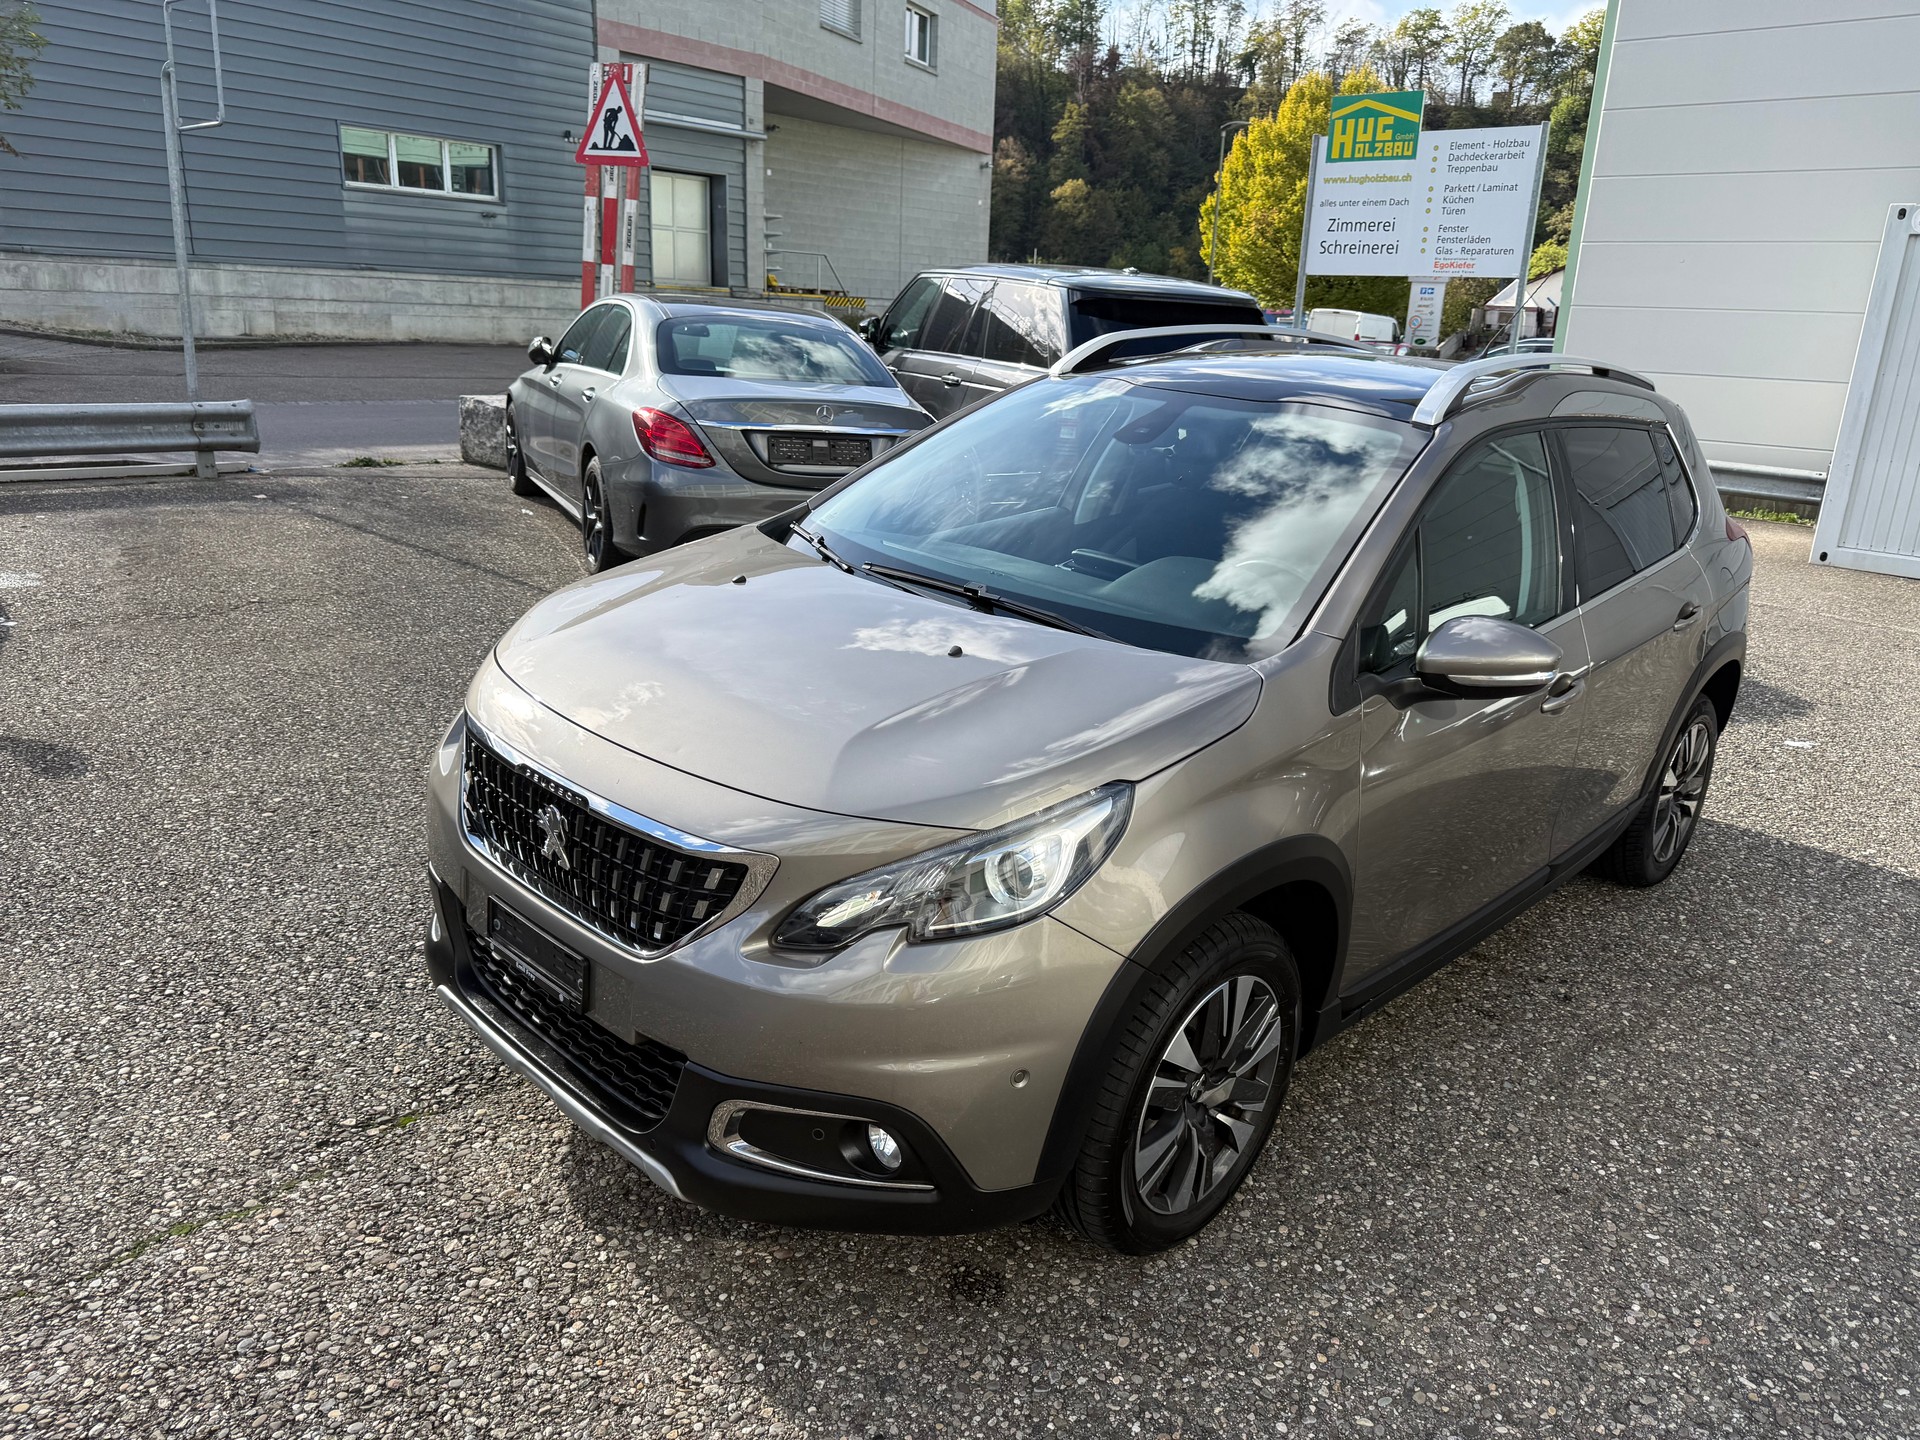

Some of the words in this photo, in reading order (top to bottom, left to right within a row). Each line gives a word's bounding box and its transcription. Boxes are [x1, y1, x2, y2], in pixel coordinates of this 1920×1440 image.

[1331, 116, 1395, 159] HUG
[1395, 133, 1415, 141] GmbH
[1449, 141, 1485, 151] Element
[1493, 139, 1531, 149] Holzbau
[1448, 150, 1525, 162] Dachdeckerarbeit
[1446, 163, 1499, 175] Treppenbau
[1323, 173, 1412, 185] www.hugholzbau.ch
[1444, 183, 1475, 193] Parkett
[1482, 183, 1518, 192] Laminat
[1320, 199, 1337, 207] alles
[1338, 199, 1360, 207] unter
[1361, 198, 1387, 207] einem
[1389, 197, 1410, 206] Dach
[1442, 195, 1475, 204] Küchen
[1441, 206, 1466, 215] Türen
[1327, 217, 1396, 232] Zimmerei
[1438, 224, 1469, 233] Fenster
[1436, 235, 1491, 244] Fensterläden
[1319, 240, 1399, 255] Schreinerei
[1435, 246, 1453, 255] Glas
[1460, 246, 1514, 256] Reparaturen
[1433, 261, 1475, 270] EgoKiefer
[525, 769, 582, 805] PEUGEOT
